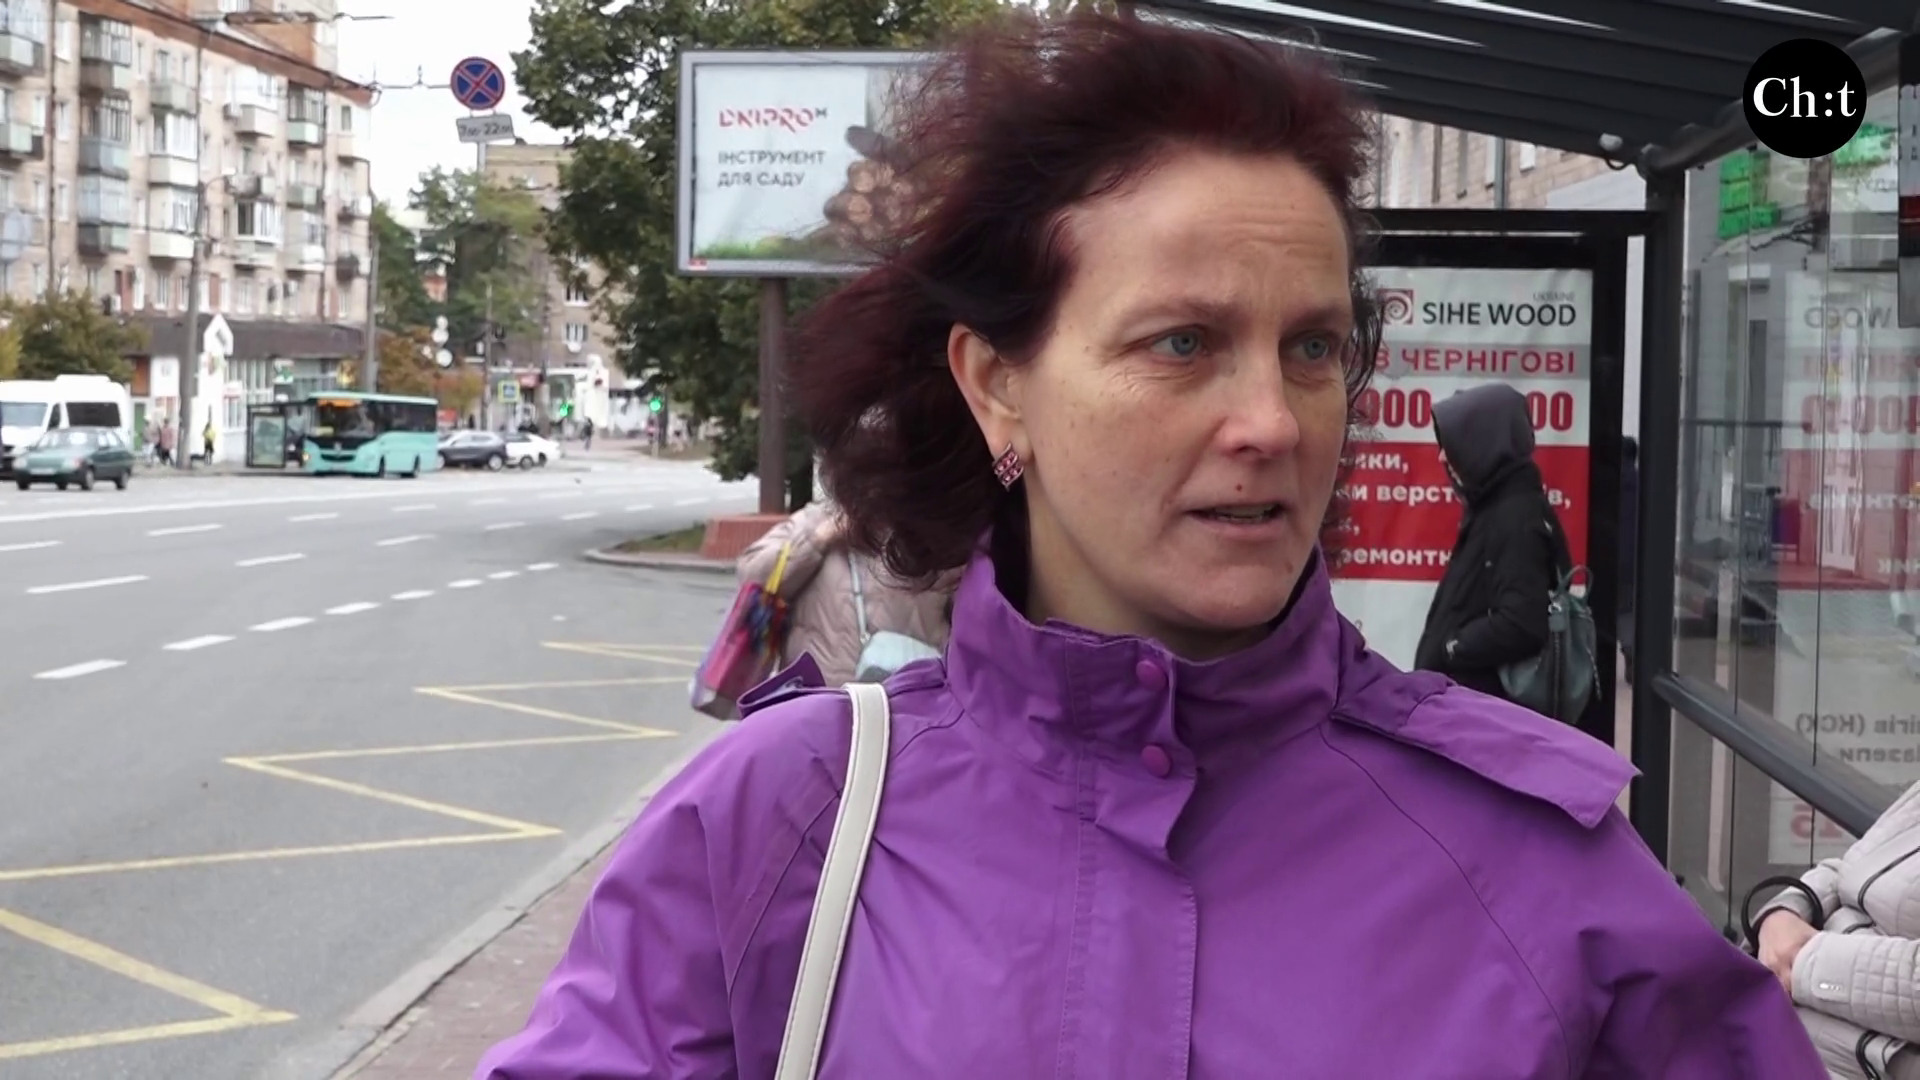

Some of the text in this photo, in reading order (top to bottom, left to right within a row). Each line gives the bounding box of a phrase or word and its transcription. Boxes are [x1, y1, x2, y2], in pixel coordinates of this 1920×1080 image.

[718, 151, 825, 164] ІНСТРУМЕНТ
[718, 172, 805, 187] ДЛЯ САДУ
[1423, 302, 1577, 327] SIHE WOOD
[1402, 350, 1575, 373] ЧЕРНІГОВІ
